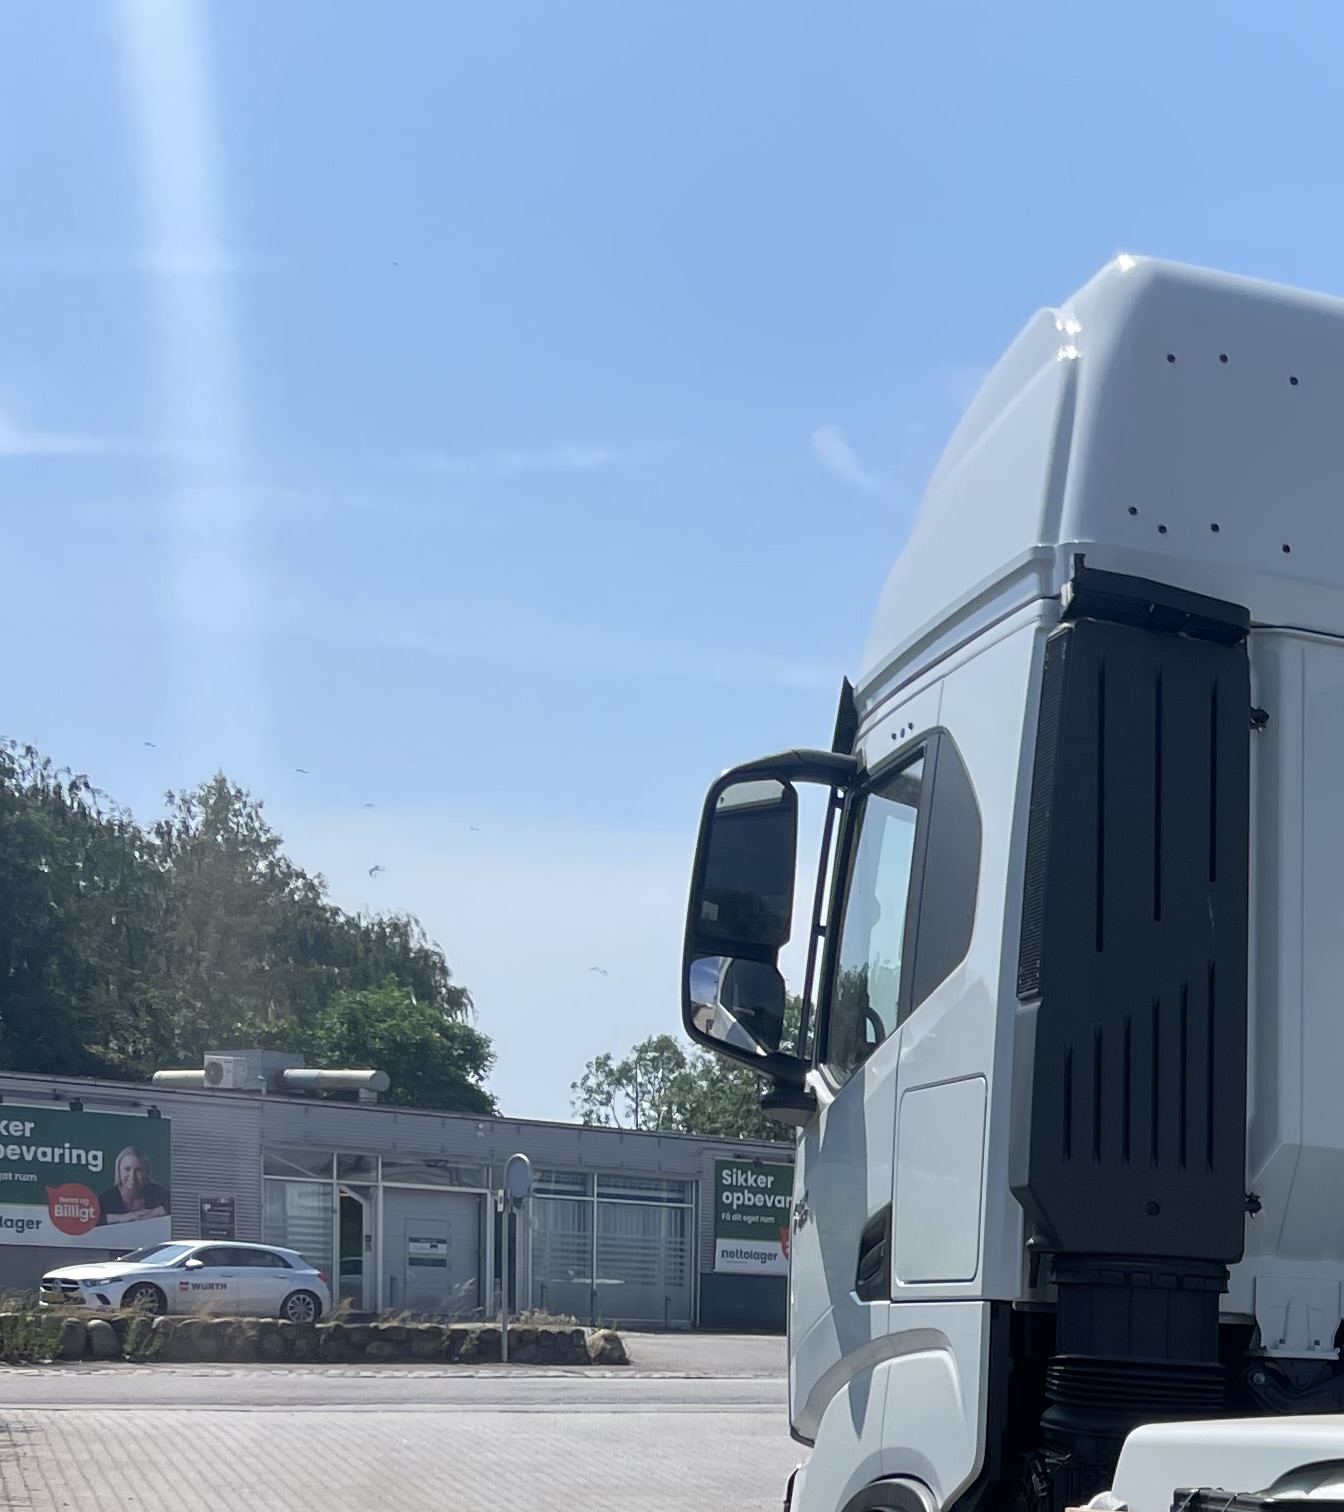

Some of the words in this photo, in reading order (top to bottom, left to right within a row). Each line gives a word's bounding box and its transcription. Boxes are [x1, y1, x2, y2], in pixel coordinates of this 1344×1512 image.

[721, 1168, 775, 1188] Sikker
[54, 1203, 96, 1223] Billigt
[721, 1249, 778, 1264] nettolager
